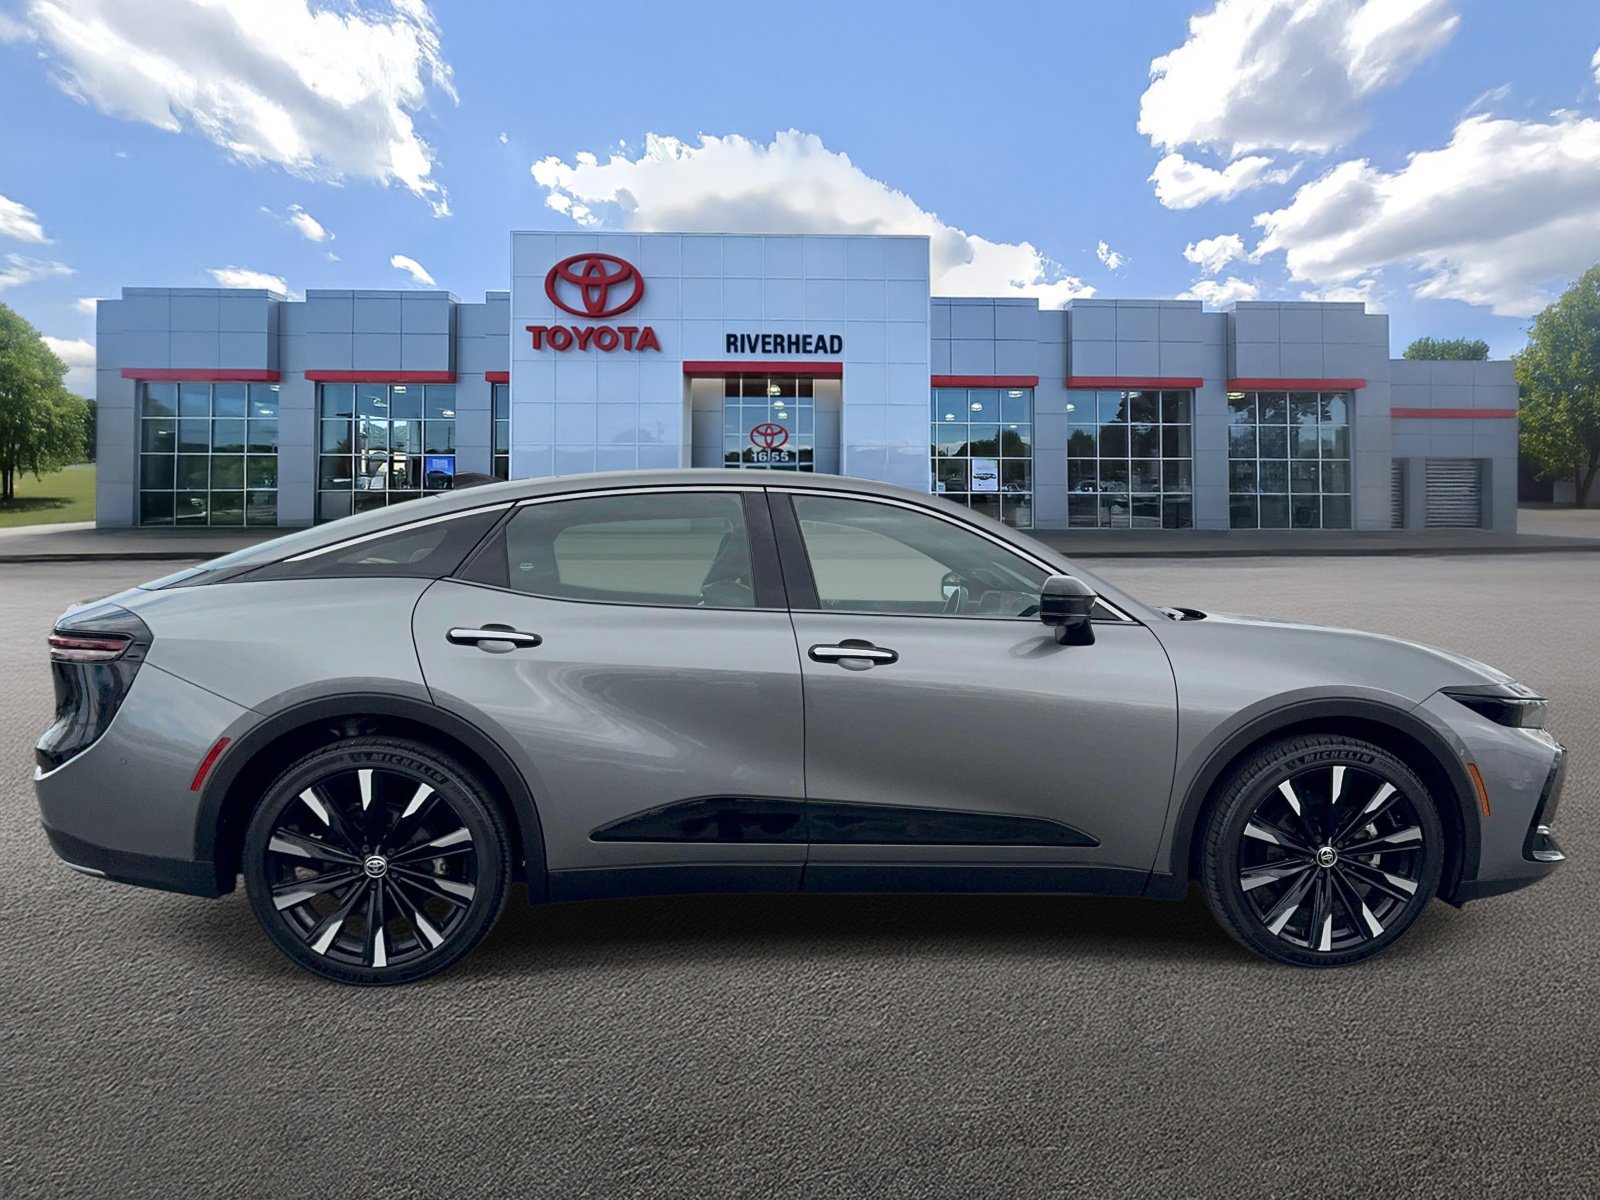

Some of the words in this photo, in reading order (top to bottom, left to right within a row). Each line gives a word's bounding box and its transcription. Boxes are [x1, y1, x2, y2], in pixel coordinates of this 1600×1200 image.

[525, 325, 661, 351] TOYOTA
[725, 333, 843, 354] RIVERHEAD
[751, 452, 789, 462] 1655
[371, 753, 446, 782] MICHELIN
[1304, 751, 1371, 763] MICHELIN
